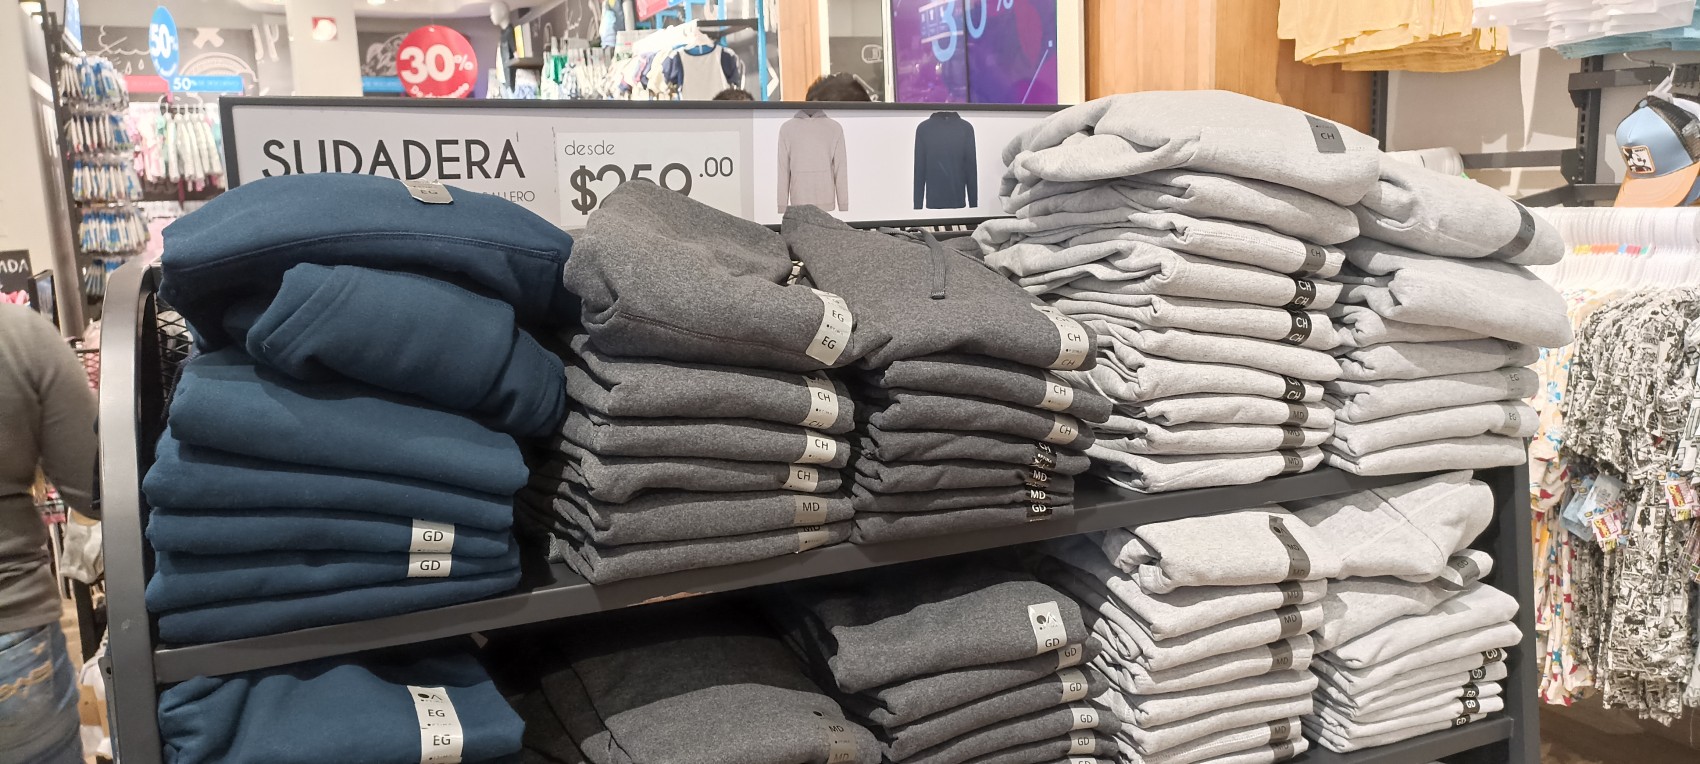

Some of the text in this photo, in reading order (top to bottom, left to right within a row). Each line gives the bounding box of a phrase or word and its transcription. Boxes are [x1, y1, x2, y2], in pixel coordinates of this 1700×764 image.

[400, 44, 474, 84] 30%
[1321, 132, 1335, 140] CH
[564, 140, 616, 155] desde
[262, 139, 525, 180] SUDADERA
[1311, 249, 1322, 257] CH
[1298, 280, 1311, 291] CH
[1295, 296, 1309, 305] CH
[832, 310, 844, 322] EG
[1296, 317, 1308, 328] CH
[1067, 333, 1081, 342] CH
[1289, 333, 1304, 342] CH
[822, 336, 837, 349] EG
[1053, 385, 1066, 396] CH
[1287, 391, 1301, 399] CH
[817, 392, 831, 402] CH
[1293, 411, 1304, 419] MD
[1059, 425, 1072, 435] CH
[815, 439, 829, 450] CH
[797, 470, 811, 481] CH
[1033, 470, 1048, 481] MD
[1030, 490, 1046, 499] MD
[803, 502, 820, 511] MD
[1031, 504, 1046, 512] GD
[422, 531, 443, 542] GD
[420, 560, 441, 571] GD
[1284, 614, 1297, 623] MD
[1045, 638, 1060, 647] GD
[1065, 648, 1077, 657] GD
[1276, 656, 1289, 665] MD
[1070, 683, 1082, 692] GD
[1466, 700, 1476, 708] GD
[428, 709, 446, 717] EG
[1080, 714, 1093, 723] GD
[1457, 717, 1467, 725] GD
[1275, 725, 1287, 734] MD
[433, 734, 451, 746] EG
[1078, 737, 1090, 746] GD
